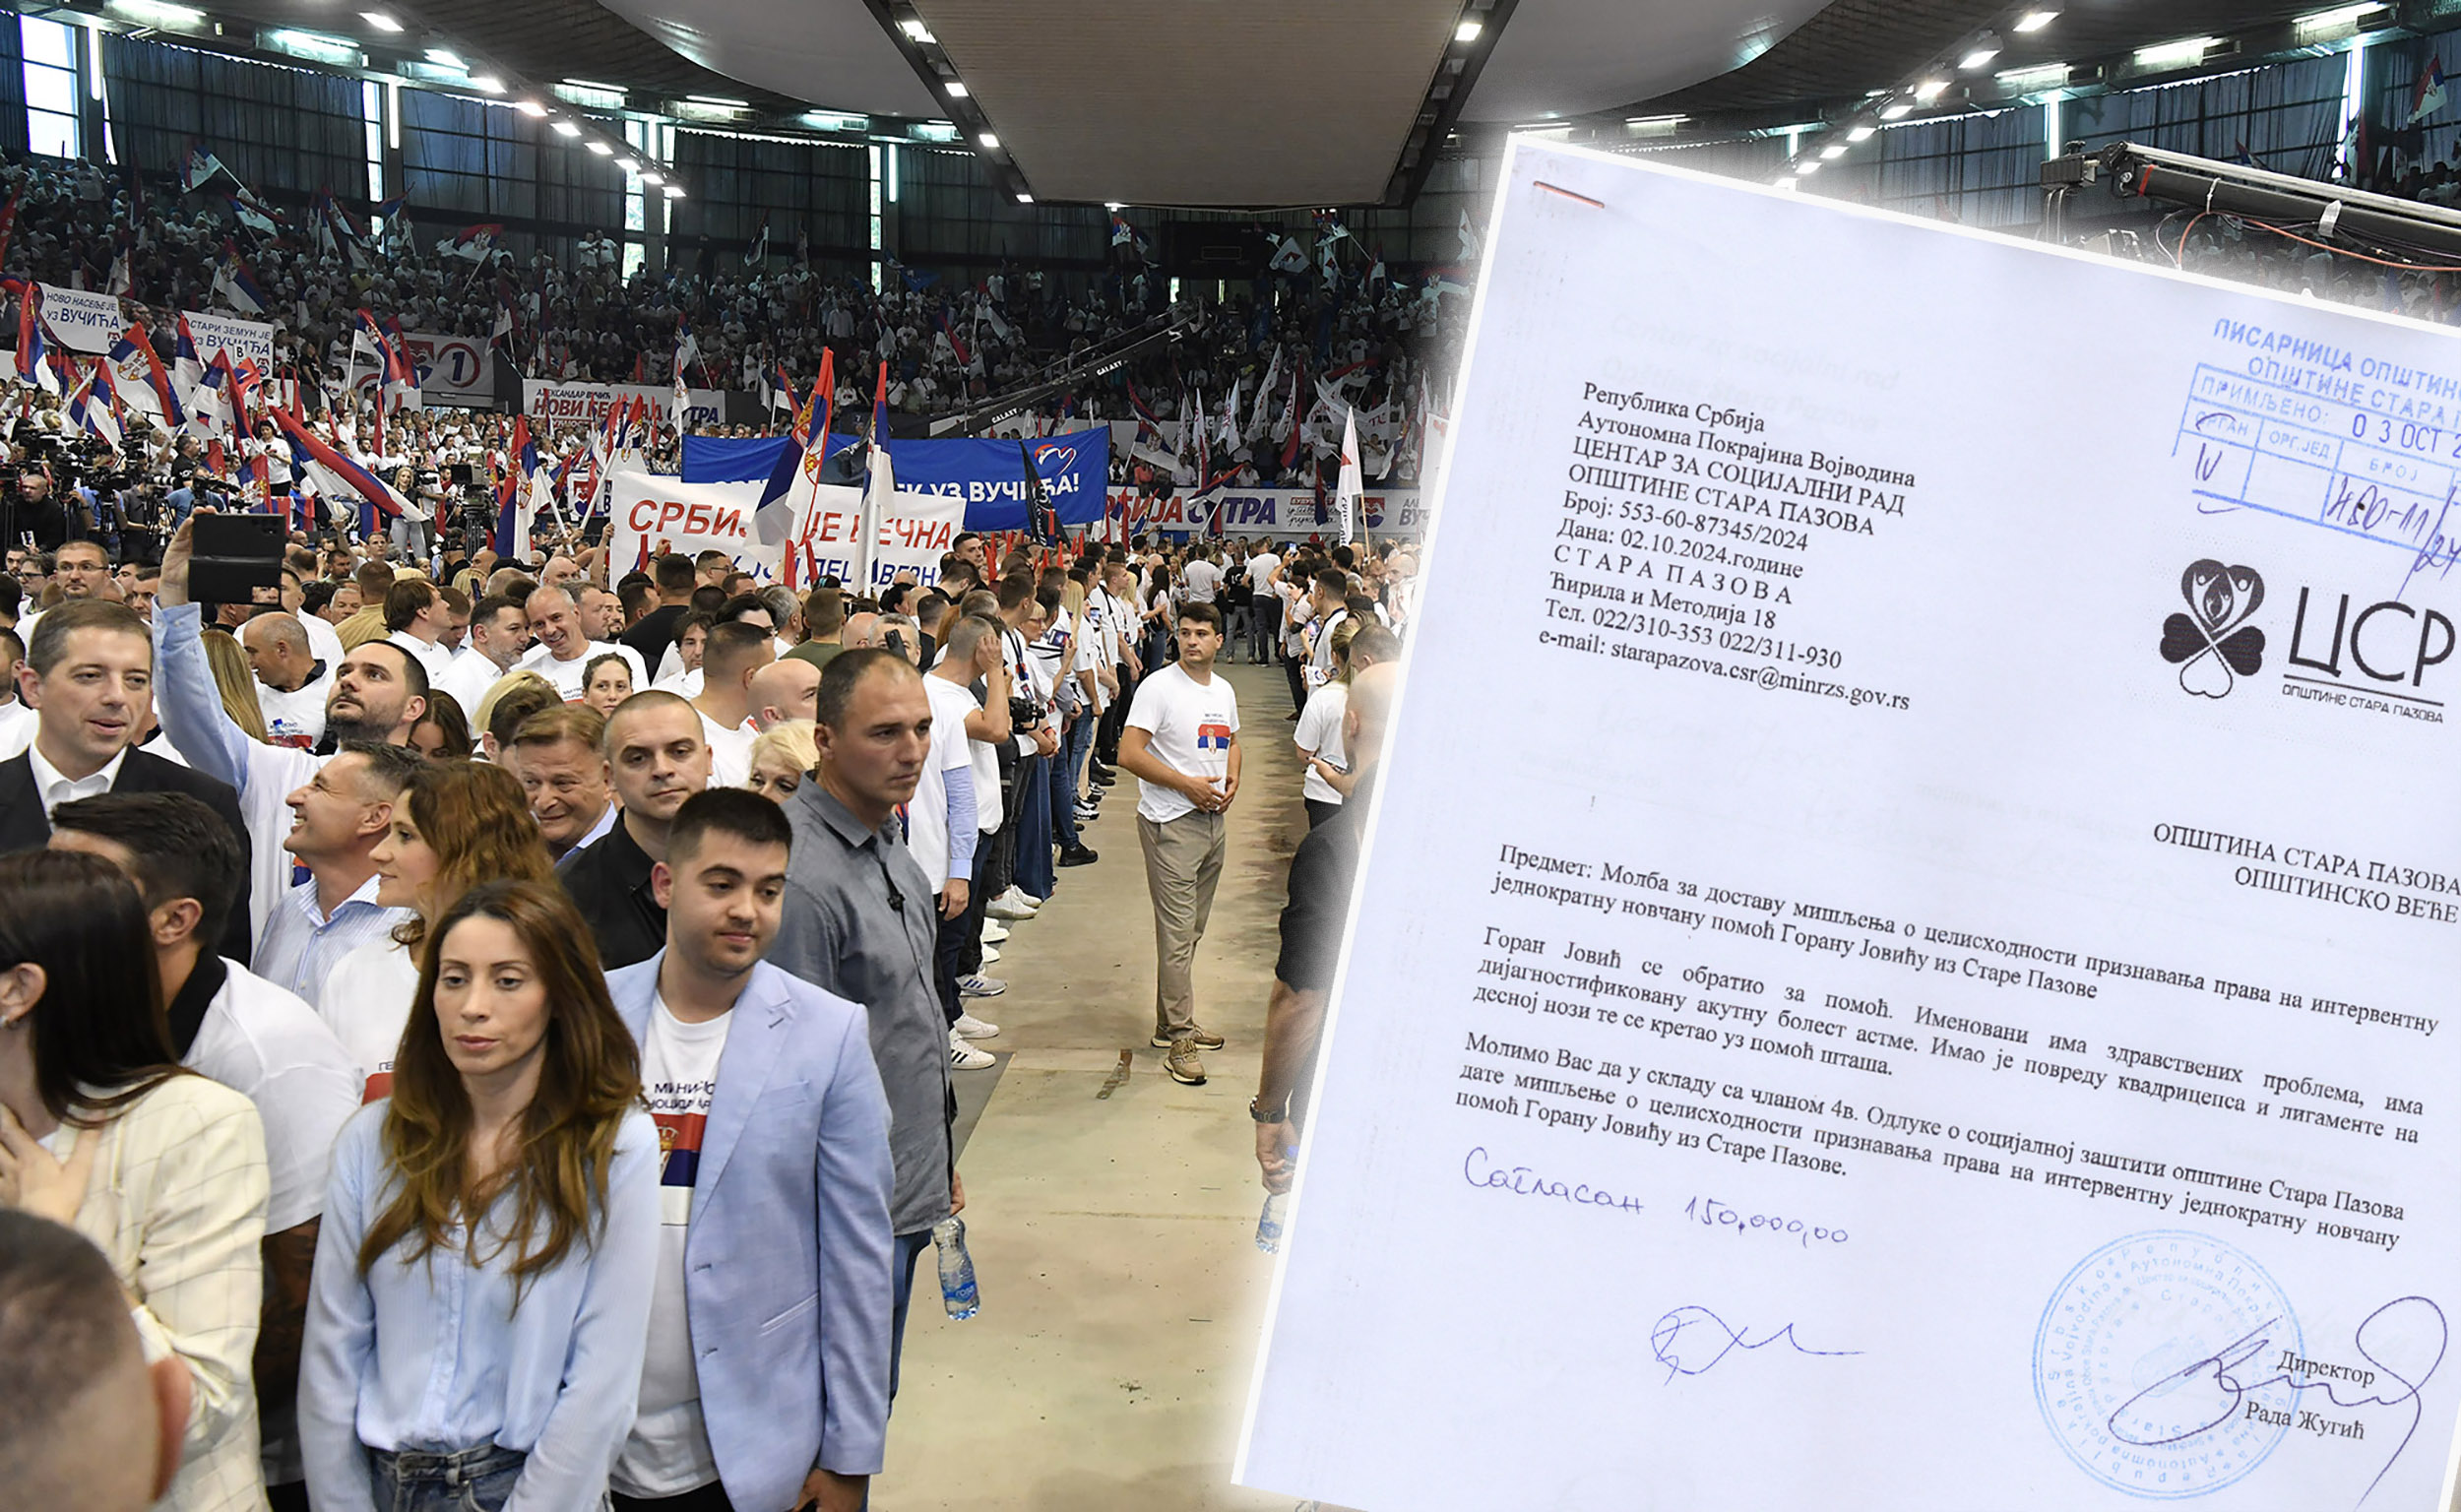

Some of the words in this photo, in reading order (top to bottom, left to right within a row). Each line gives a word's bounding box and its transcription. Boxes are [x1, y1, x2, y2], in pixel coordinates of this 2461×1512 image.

[46, 291, 72, 304] НОВО
[60, 308, 119, 329] ВУЧИЋА
[190, 319, 221, 332] СТАРИ
[223, 325, 257, 338] ЗЕМУН
[258, 331, 271, 341] ЈЕ
[453, 351, 466, 382] 1
[1097, 359, 1123, 376] GALAXY
[2213, 318, 2353, 373] ПИСАРНИЦА
[2361, 357, 2461, 402] ОПШТИН
[2247, 356, 2366, 406] ОПШТИНЕ
[2370, 389, 2445, 425] СТАРА
[991, 408, 1018, 424] GALAXY
[1583, 381, 1689, 419] Република
[1695, 403, 1765, 435] Србија
[2200, 375, 2330, 424] ПРИМЉЕНО:
[1572, 435, 1668, 470] ЦЕНТАР
[1671, 453, 1701, 476] ЗА
[1707, 461, 1854, 505] СОЦИЈАЛНИ
[1856, 486, 1906, 518] РАД
[1577, 410, 1691, 447] Аутономна
[1696, 430, 1804, 469] Покрајина
[1807, 450, 1916, 488] Војводина
[2369, 458, 2419, 481] БРОЈ
[1563, 489, 1613, 520] Број:
[1618, 500, 1808, 552] 553-60-87345/2024
[1568, 463, 1690, 502] ОПШТИНЕ
[1694, 486, 1772, 518] СТАРА
[1777, 500, 1874, 536] ПАЗОВА
[1555, 517, 1614, 544] Дана:
[1620, 528, 1804, 579] 02.10.2024.године
[1545, 598, 1586, 623] Тел.
[1592, 607, 1713, 646] 022/310-353
[1719, 630, 1843, 669] 022/311-930
[1549, 570, 1626, 602] Ћирила
[1630, 591, 1645, 606] и
[1649, 588, 1746, 627] Методија
[1753, 608, 1777, 630] 18
[1539, 630, 1606, 655] e-mail:
[1610, 642, 1911, 711] starapazova.csr@minrzs.gov.rs
[2288, 586, 2457, 688] ЦСР
[2281, 683, 2348, 707] ОПШТИНЕ
[2349, 696, 2390, 714] СТАРА
[2392, 704, 2444, 724] ПАЗОВА
[2153, 822, 2277, 863] ОПШТИНА
[2283, 847, 2361, 879] СТАРА
[2366, 860, 2461, 897] ПАЗОВА
[2235, 865, 2391, 912] ОПШТИНСКО
[2394, 894, 2459, 924] ВЕЋЕ
[1489, 870, 1617, 914] једнократну
[1621, 899, 1706, 931] новчану
[1711, 915, 1775, 941] помоћ
[1780, 922, 1856, 959] Горану
[1859, 938, 1929, 973] Јовићу
[1933, 957, 1957, 975] из
[1962, 957, 2022, 988] Старе
[2027, 968, 2098, 999] Пазове
[1499, 844, 1593, 879] Предмет:
[1600, 861, 1670, 893] Молба
[1676, 881, 1698, 898] за
[1703, 887, 1787, 917] доставу
[1792, 902, 1896, 934] мишљења
[1903, 923, 1917, 938] о
[1924, 926, 2078, 968] целисходности
[2084, 956, 2205, 991] признавања
[2213, 978, 2271, 1003] права
[2278, 991, 2303, 1009] на
[2309, 997, 2439, 1038] интервентну
[1472, 985, 1540, 1015] десној
[1543, 999, 1592, 1020] нози
[1596, 1008, 1618, 1025] те
[1622, 1013, 1645, 1030] се
[1649, 1018, 1718, 1042] кретао
[1721, 1032, 1745, 1050] уз
[1748, 1037, 1814, 1061] помоћ
[1819, 1049, 1893, 1076] шташа.
[1477, 957, 1688, 1013] дијагностификовану
[1696, 999, 1768, 1029] акутну
[1777, 1009, 1848, 1039] болест
[1856, 1028, 1919, 1052] астме.
[1929, 1036, 1986, 1064] Имао
[1991, 1047, 2014, 1072] је
[2023, 1058, 2109, 1091] повреду
[2117, 1075, 2246, 1112] квадрицепса
[2255, 1102, 2270, 1116] и
[2279, 1105, 2385, 1137] лигаменте
[2394, 1127, 2419, 1144] на
[1483, 925, 1546, 955] Горан
[1563, 941, 1621, 970] Јовић
[1641, 961, 1664, 976] се
[1682, 965, 1765, 995] обратио
[1783, 986, 1805, 1003] за
[1824, 993, 1893, 1020] помоћ.
[1914, 1005, 2030, 1044] Именовани
[2048, 1035, 2088, 1054] има
[2107, 1044, 2244, 1084] здравствених
[2262, 1073, 2365, 1109] проблема,
[2383, 1096, 2424, 1116] има
[1458, 1064, 1505, 1085] дате
[1513, 1074, 1616, 1105] мишљење
[1625, 1095, 1639, 1109] о
[1648, 1099, 1803, 1140] целисходности
[1812, 1129, 1932, 1164] признавања
[1942, 1152, 2000, 1176] права
[2009, 1165, 2035, 1182] на
[2044, 1170, 2174, 1211] интервентну
[2178, 1197, 2307, 1235] једнократну
[2315, 1221, 2401, 1253] новчану
[1465, 1031, 1549, 1064] Молимо
[1554, 1047, 1594, 1073] Вас
[1597, 1061, 1622, 1079] да
[1625, 1065, 1642, 1085] у
[1646, 1069, 1717, 1099] складу
[1722, 1084, 1744, 1101] са
[1750, 1089, 1826, 1115] чланом
[1830, 1099, 1859, 1121] 4в.
[1866, 1105, 1942, 1136] Одлуке
[1947, 1125, 1961, 1140] о
[1966, 1128, 2075, 1166] социјалној
[2079, 1149, 2167, 1178] заштити
[2172, 1166, 2263, 1195] општине
[2268, 1178, 2328, 1209] Стара
[2333, 1190, 2404, 1222] Пазова
[1464, 1147, 1645, 1214] Сагласан
[2276, 1350, 2375, 1389] Директор
[2244, 1400, 2293, 1427] Рада
[2297, 1410, 2365, 1440] Жугић
